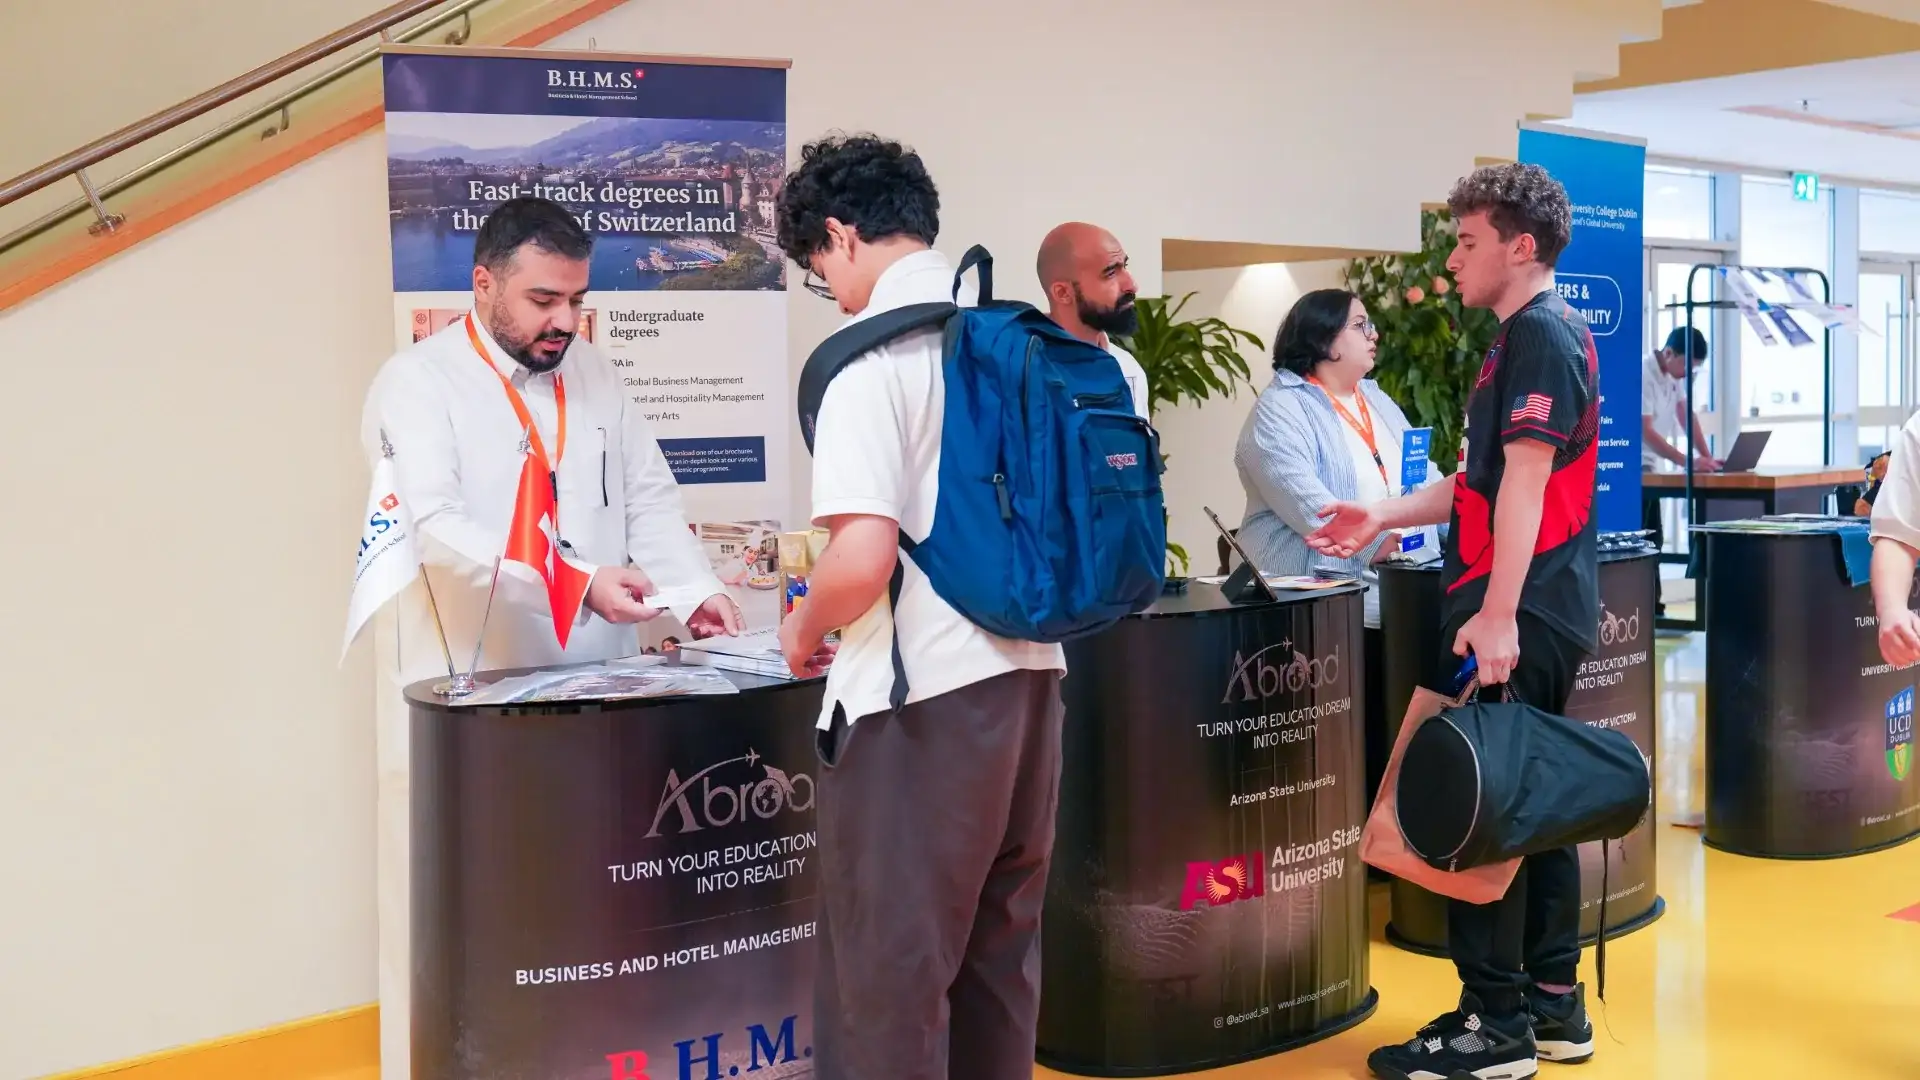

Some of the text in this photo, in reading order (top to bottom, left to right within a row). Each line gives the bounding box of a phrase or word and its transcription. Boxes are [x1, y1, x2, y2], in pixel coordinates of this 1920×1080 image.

[547, 69, 638, 89] B.H.M.S.
[468, 180, 720, 209] Fast-track degrees in
[598, 211, 736, 233] Switzerland
[1596, 205, 1618, 220] College
[1619, 207, 1638, 219] Dublin
[1585, 219, 1601, 228] Global
[1601, 220, 1625, 231] University
[1581, 284, 1590, 300] &
[609, 309, 705, 326] Undergraduate
[610, 325, 660, 340] degrees
[625, 359, 634, 367] in
[652, 376, 689, 386] Business
[690, 376, 744, 387] Management
[649, 395, 665, 403] and
[666, 394, 711, 404] Hospitality
[712, 393, 765, 403] Management
[662, 412, 680, 420] Arts
[1610, 438, 1629, 447] Service
[1855, 616, 1876, 628] TURN
[1588, 656, 1629, 673] EDUCATION
[1629, 650, 1647, 666] DREAM
[1220, 645, 1340, 704] Abroad
[1575, 672, 1624, 690] INTO REALITY
[1197, 697, 1351, 738] TURN YOUR EDUCATION DREAM
[1598, 718, 1609, 729] OF
[1609, 712, 1637, 728] VICTORIA
[1889, 714, 1912, 735] UCD
[1253, 723, 1319, 750] INTO REALITY
[1230, 773, 1336, 807] Arizona State University
[643, 767, 816, 839] Abroa
[1271, 824, 1361, 868] Arizona State
[608, 831, 817, 883] TURN YOUR EDUCATION
[696, 857, 806, 894] INTO REALITY
[1178, 849, 1265, 911] ASU
[1271, 857, 1345, 893] University
[515, 962, 614, 985] BUSINESS
[618, 954, 659, 976] AND
[663, 944, 719, 968] HOTEL
